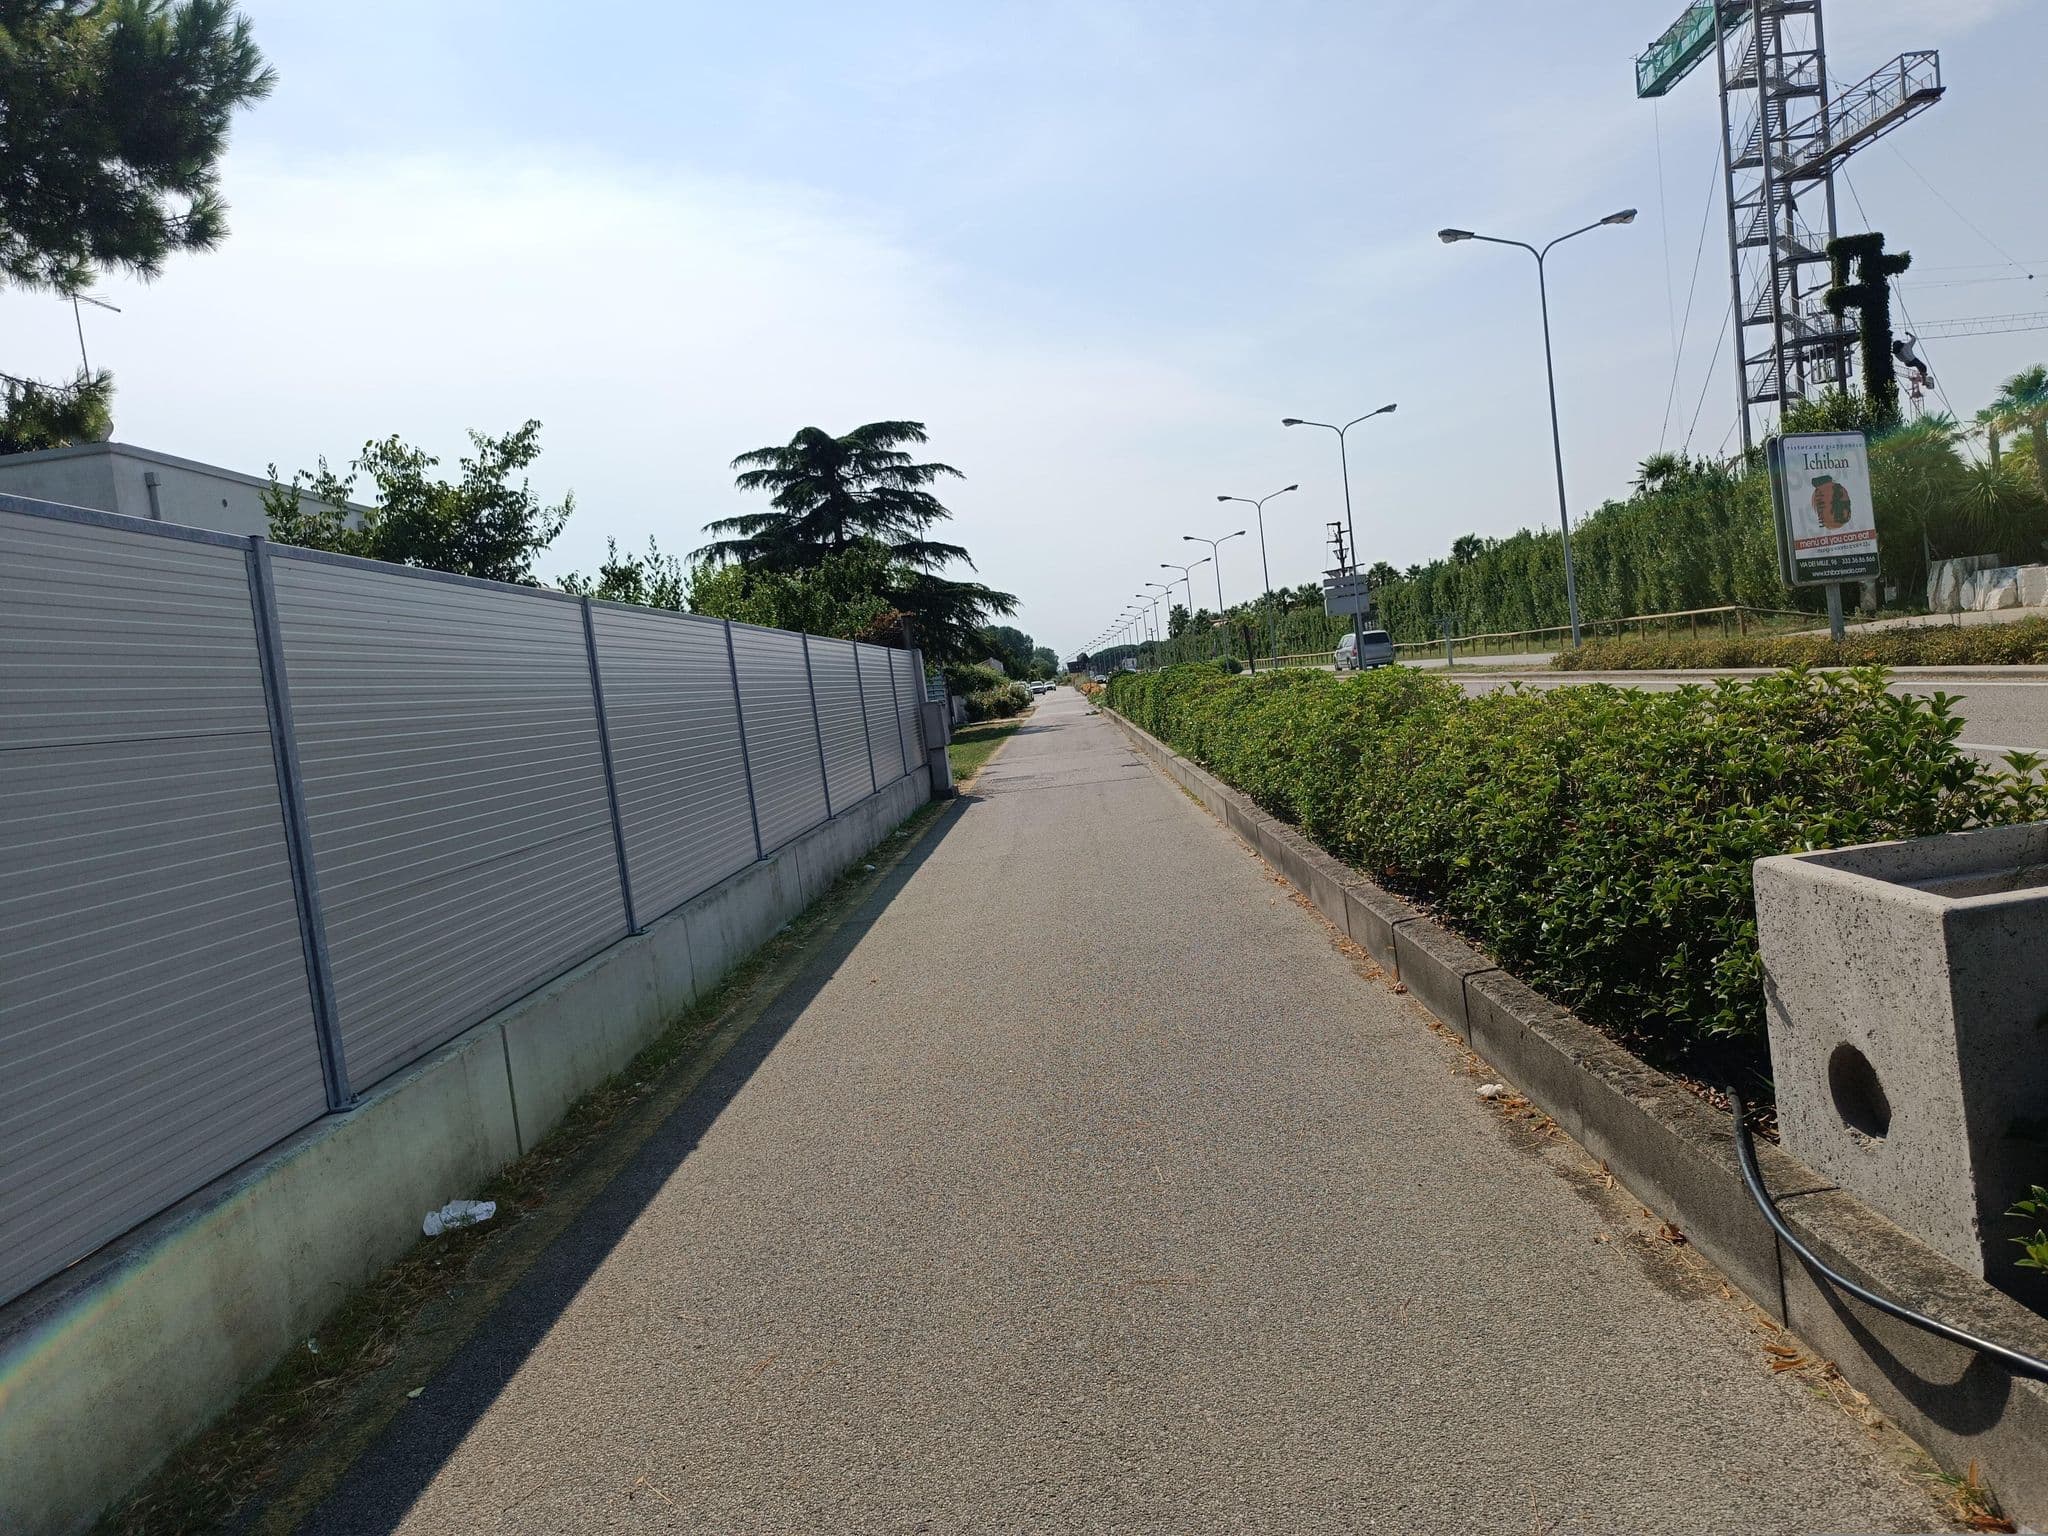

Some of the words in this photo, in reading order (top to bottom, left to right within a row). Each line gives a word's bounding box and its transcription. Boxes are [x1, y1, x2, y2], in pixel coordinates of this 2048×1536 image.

[1802, 452, 1849, 470] Ichiban
[1820, 537, 1829, 545] all
[1829, 536, 1842, 545] you
[1843, 534, 1857, 542] can
[1858, 531, 1869, 539] eat
